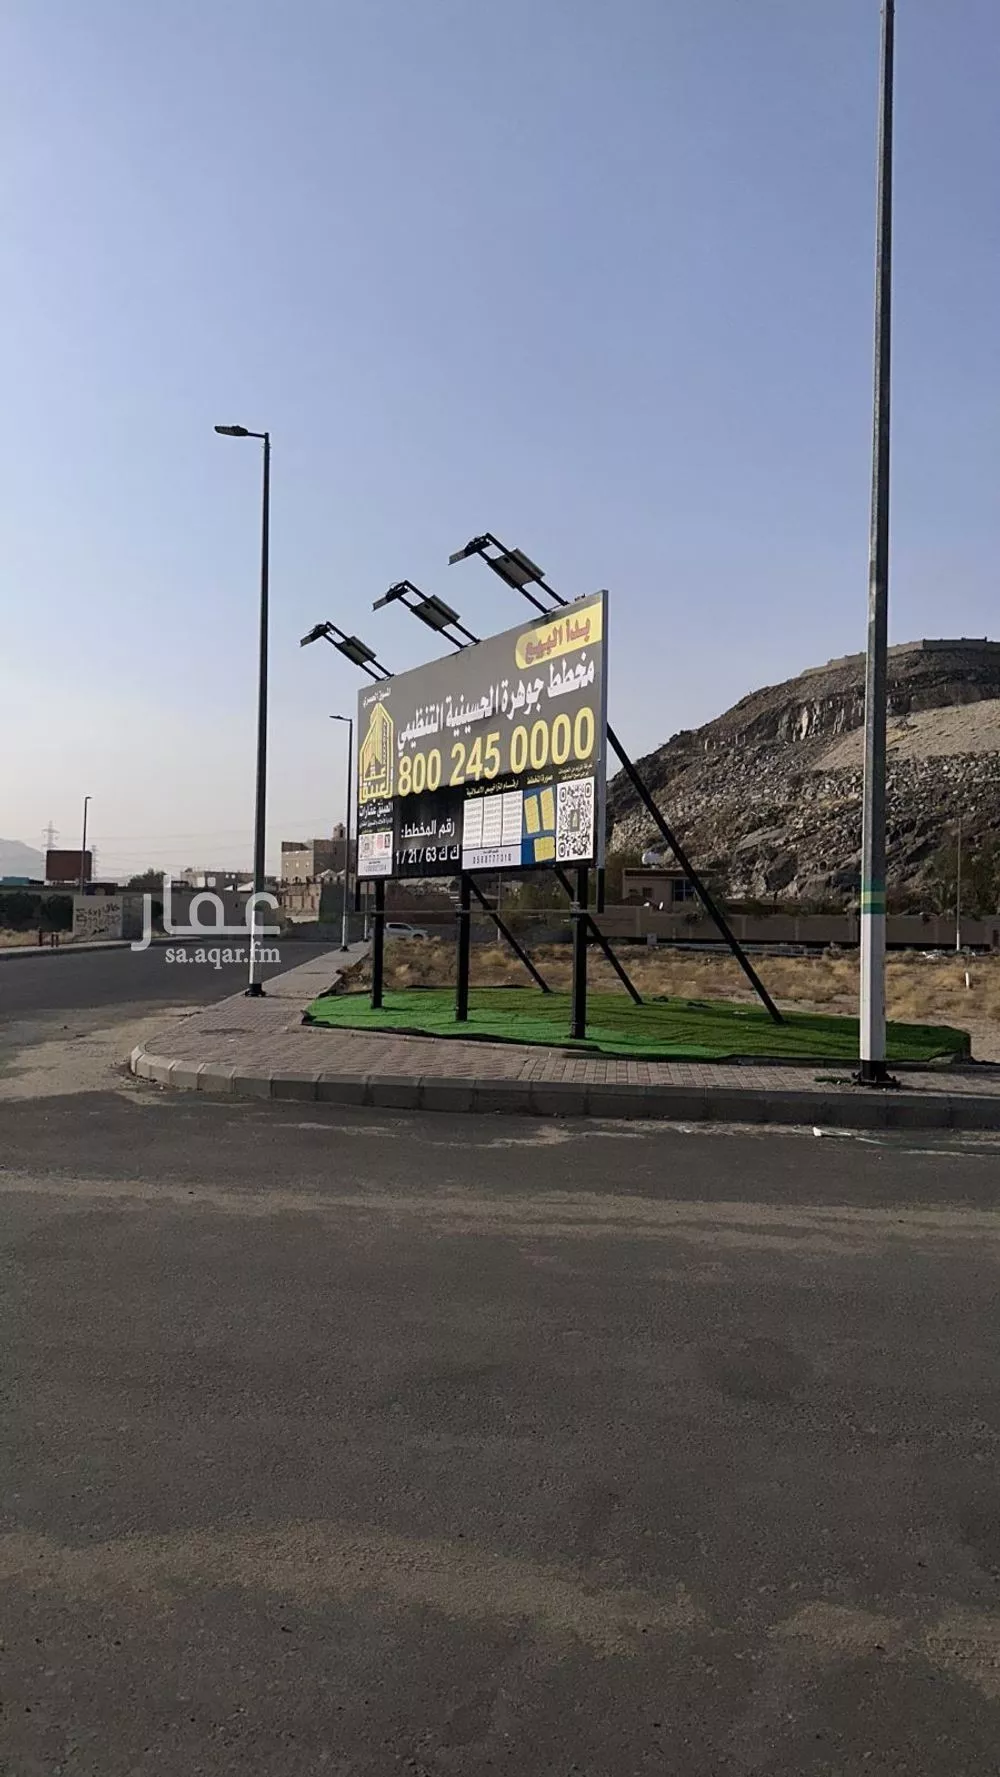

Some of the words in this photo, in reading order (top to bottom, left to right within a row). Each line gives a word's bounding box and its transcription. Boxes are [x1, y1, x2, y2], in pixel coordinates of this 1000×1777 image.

[525, 624, 563, 665] البيع
[547, 651, 595, 698] مخطط
[445, 683, 499, 737] الحسينية
[501, 677, 544, 720] جوهرة
[397, 702, 444, 757] التنظيمي
[398, 748, 441, 797] 800
[449, 731, 500, 787] 245
[510, 706, 595, 774] 0000
[438, 818, 455, 839] رقم
